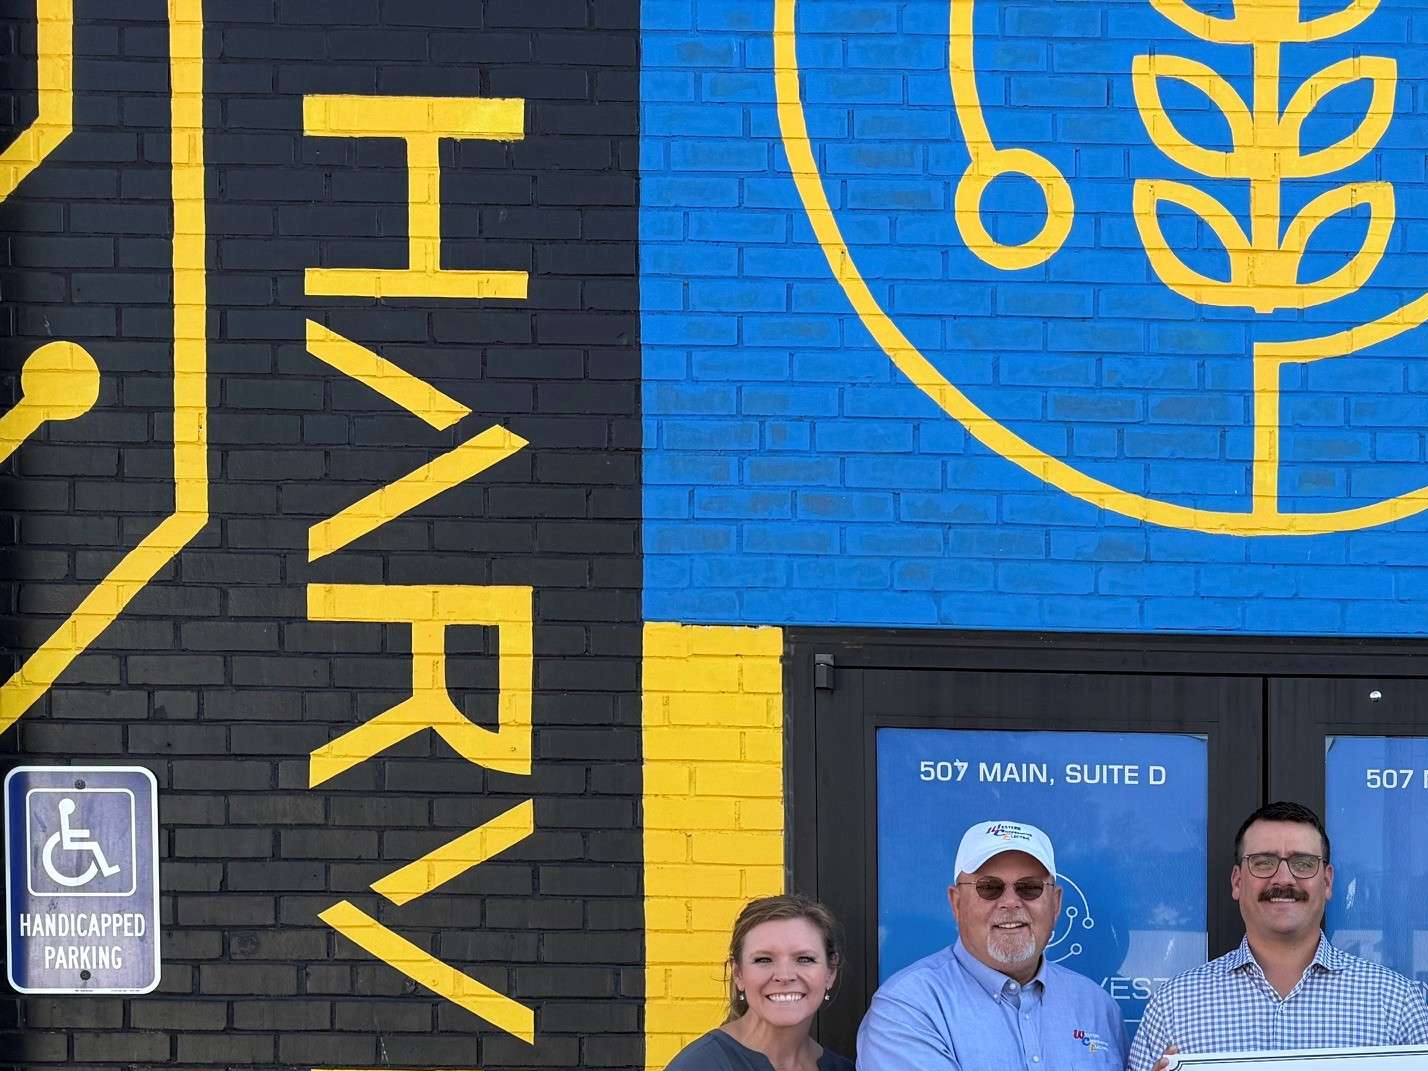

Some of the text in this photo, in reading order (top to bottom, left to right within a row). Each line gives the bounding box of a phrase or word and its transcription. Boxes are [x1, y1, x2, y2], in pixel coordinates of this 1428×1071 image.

[919, 758, 1166, 786] 507 MAIN, SUITE D
[1366, 769, 1414, 789] 507
[20, 913, 146, 937] HANDICAPPED
[44, 945, 123, 970] PARKING
